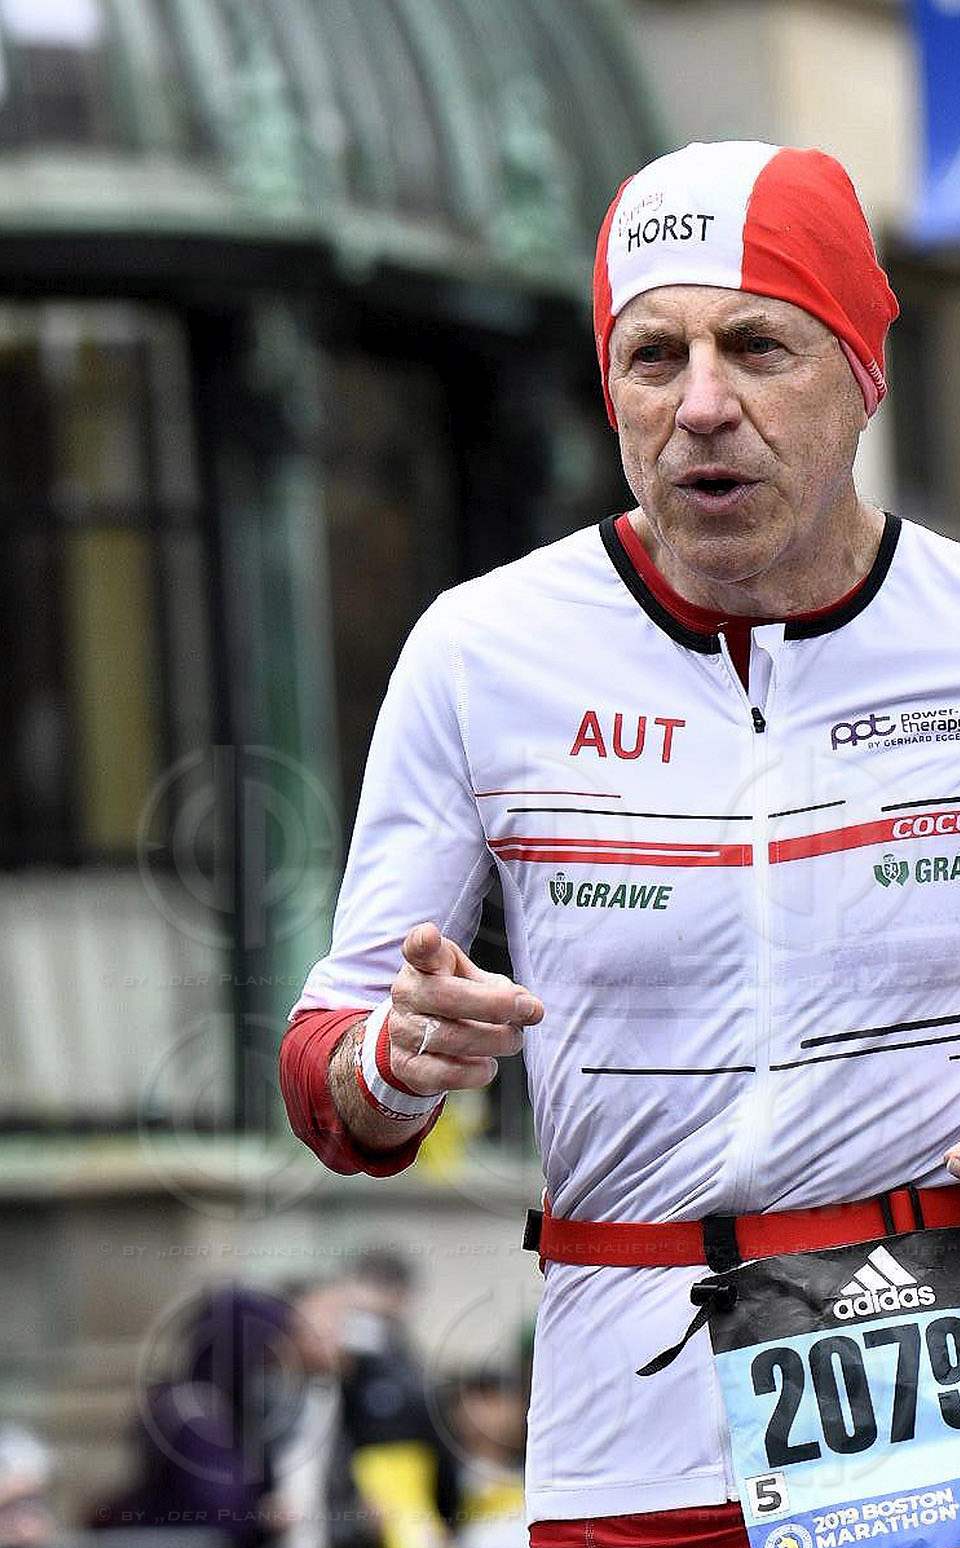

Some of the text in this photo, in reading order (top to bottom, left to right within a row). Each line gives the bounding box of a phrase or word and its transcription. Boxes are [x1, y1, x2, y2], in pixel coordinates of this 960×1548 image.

[627, 213, 715, 253] HORST
[569, 710, 687, 763] AUT
[830, 713, 897, 751] ppt
[884, 735, 932, 747] GERHARD
[576, 882, 674, 910] GRAWE
[832, 1283, 937, 1321] adidas
[755, 1477, 783, 1513] 5
[812, 1487, 954, 1533] 2019 BOSTON
